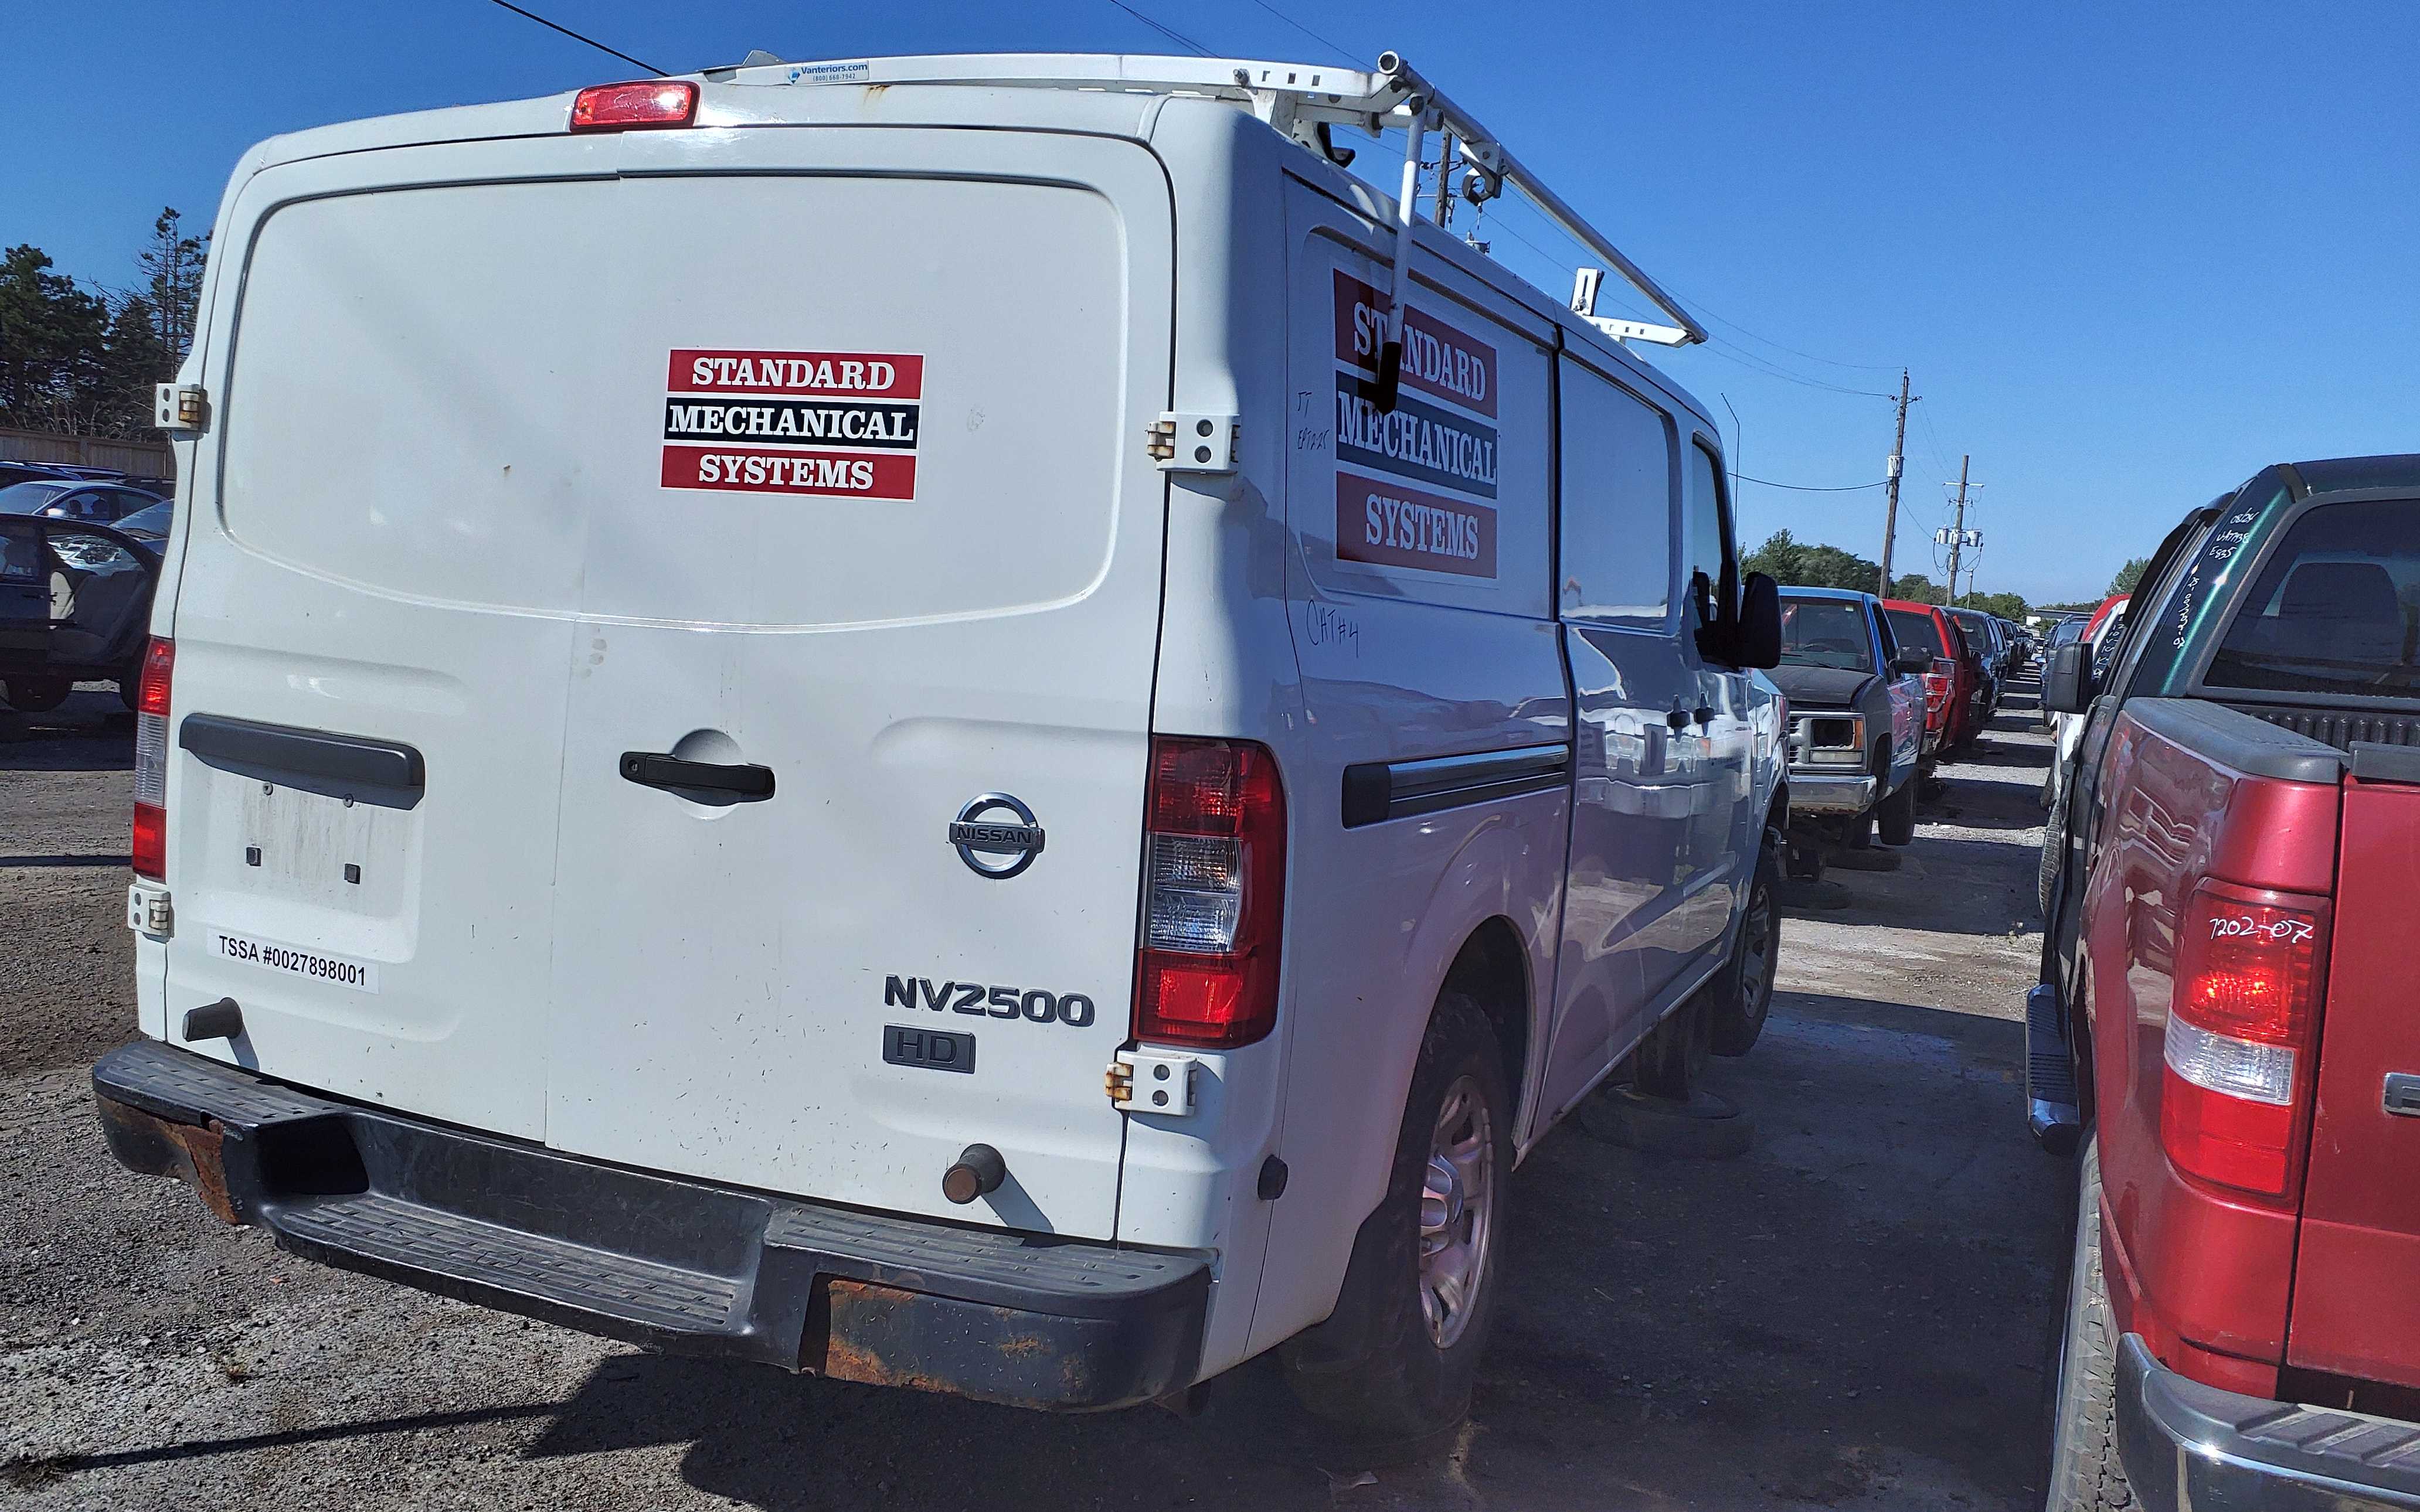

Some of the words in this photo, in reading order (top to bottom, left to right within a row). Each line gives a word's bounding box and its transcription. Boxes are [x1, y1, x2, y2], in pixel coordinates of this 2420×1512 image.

[801, 63, 868, 74] Vanteriors.com
[813, 74, 828, 82] (800)
[1354, 301, 1487, 402] STNDARD
[692, 357, 895, 390] STANDARD
[668, 405, 913, 441] MECHANICAL
[698, 454, 873, 490] SYSTEMS
[1366, 492, 1479, 561] SYSTEMS
[956, 827, 1032, 844] NISSAN
[219, 935, 259, 962] TSSA
[263, 945, 366, 986] #0027898001
[884, 973, 1096, 1028] NV2500
[896, 1031, 957, 1064] HD
